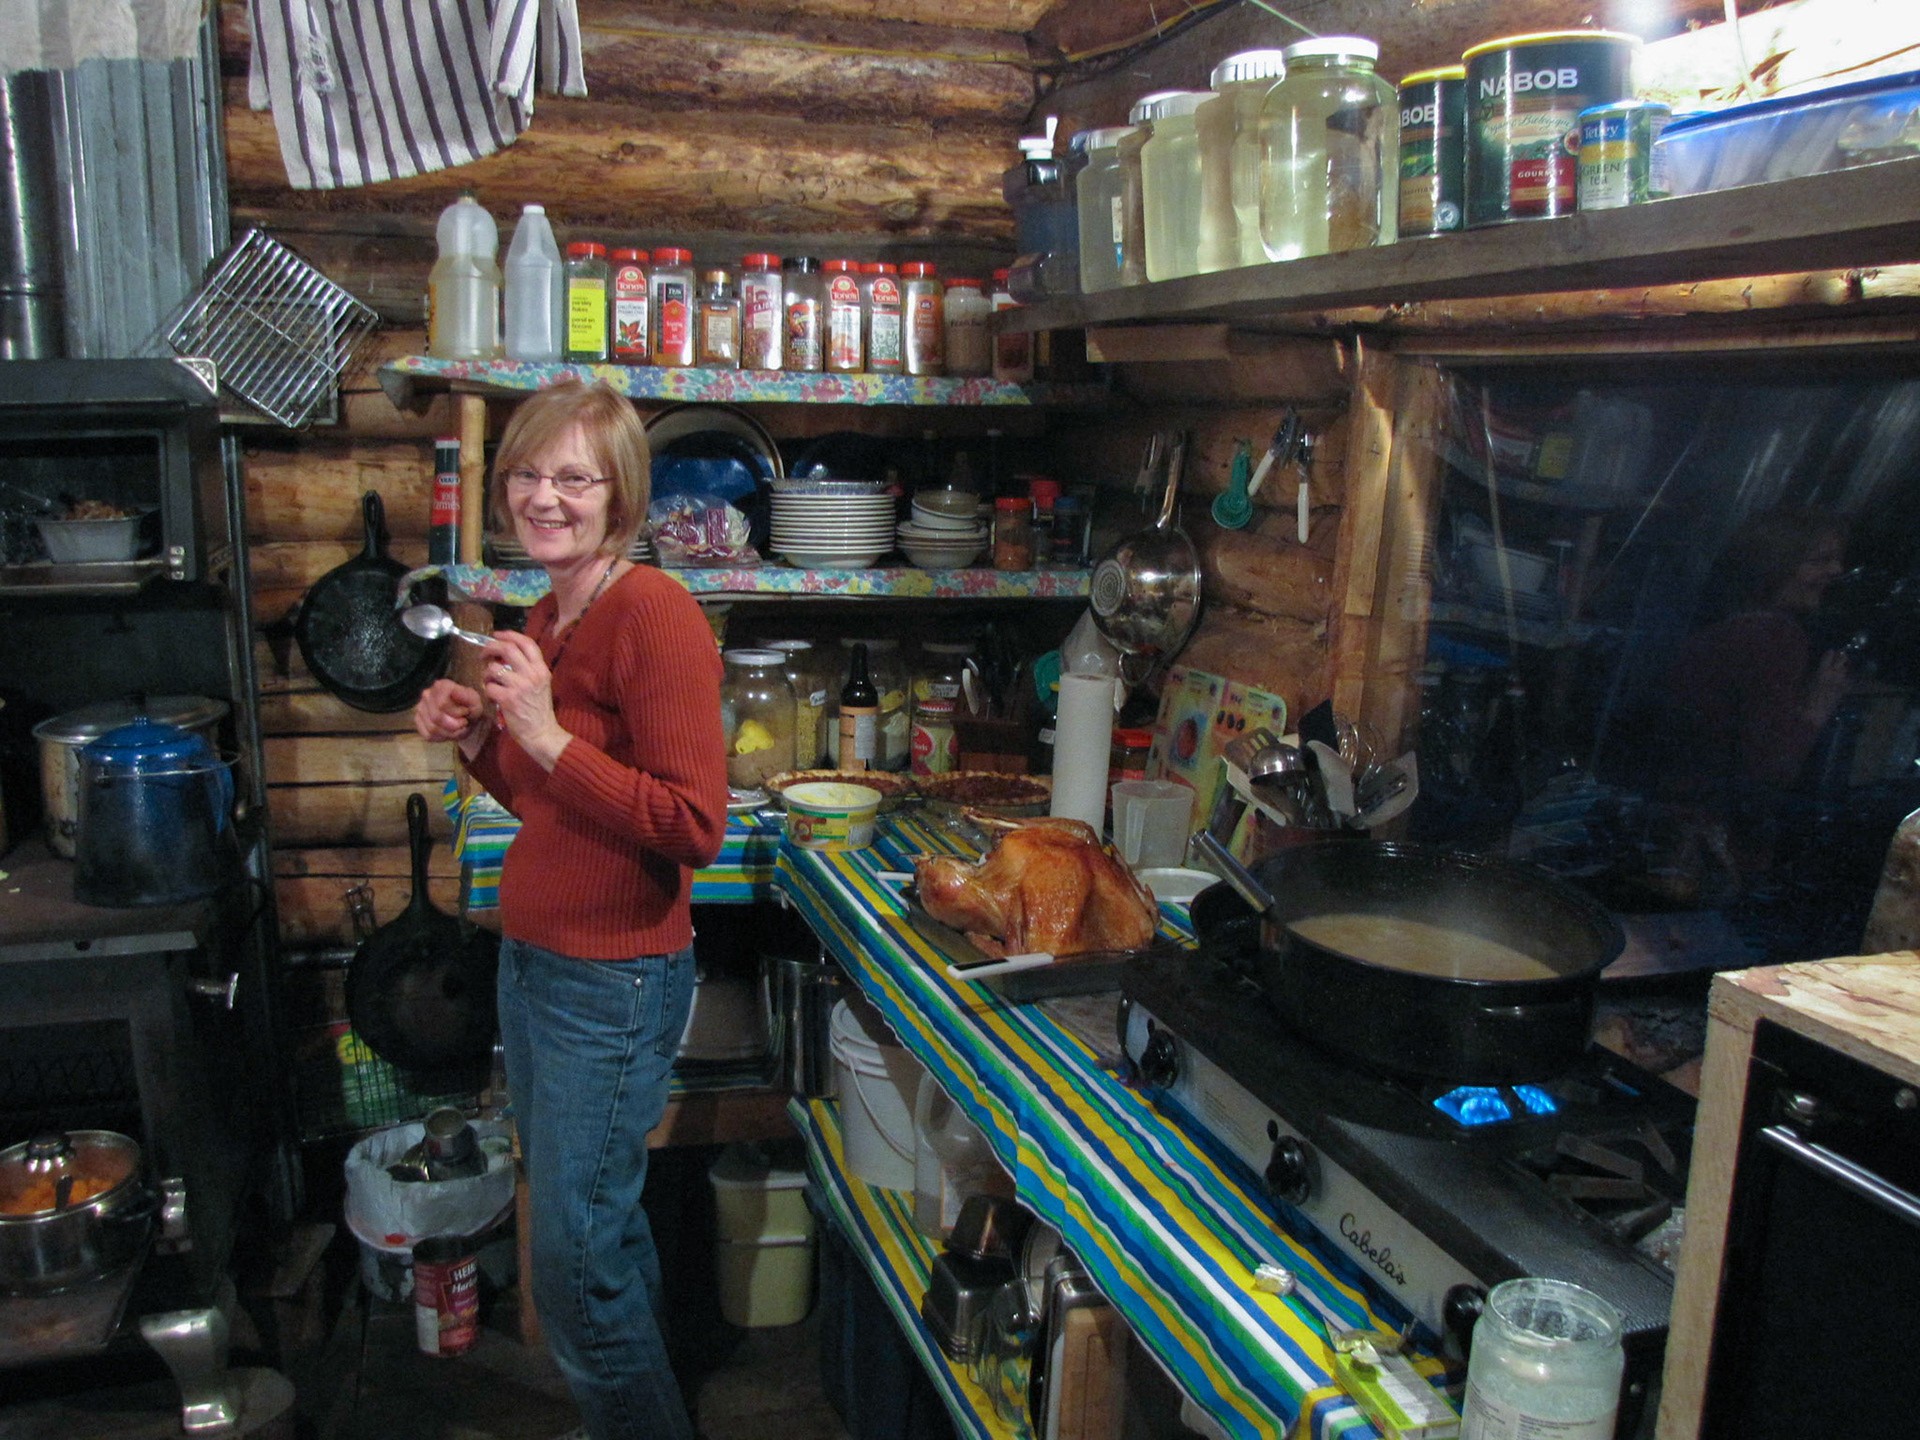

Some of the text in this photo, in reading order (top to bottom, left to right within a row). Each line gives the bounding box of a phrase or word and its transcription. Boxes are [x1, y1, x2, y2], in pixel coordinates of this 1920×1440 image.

[1480, 68, 1578, 99] NABOB
[1401, 103, 1438, 128] BOB
[1517, 169, 1564, 179] GOURMT
[1582, 163, 1620, 176] GREEN
[1340, 1213, 1407, 1285] Cabela's
